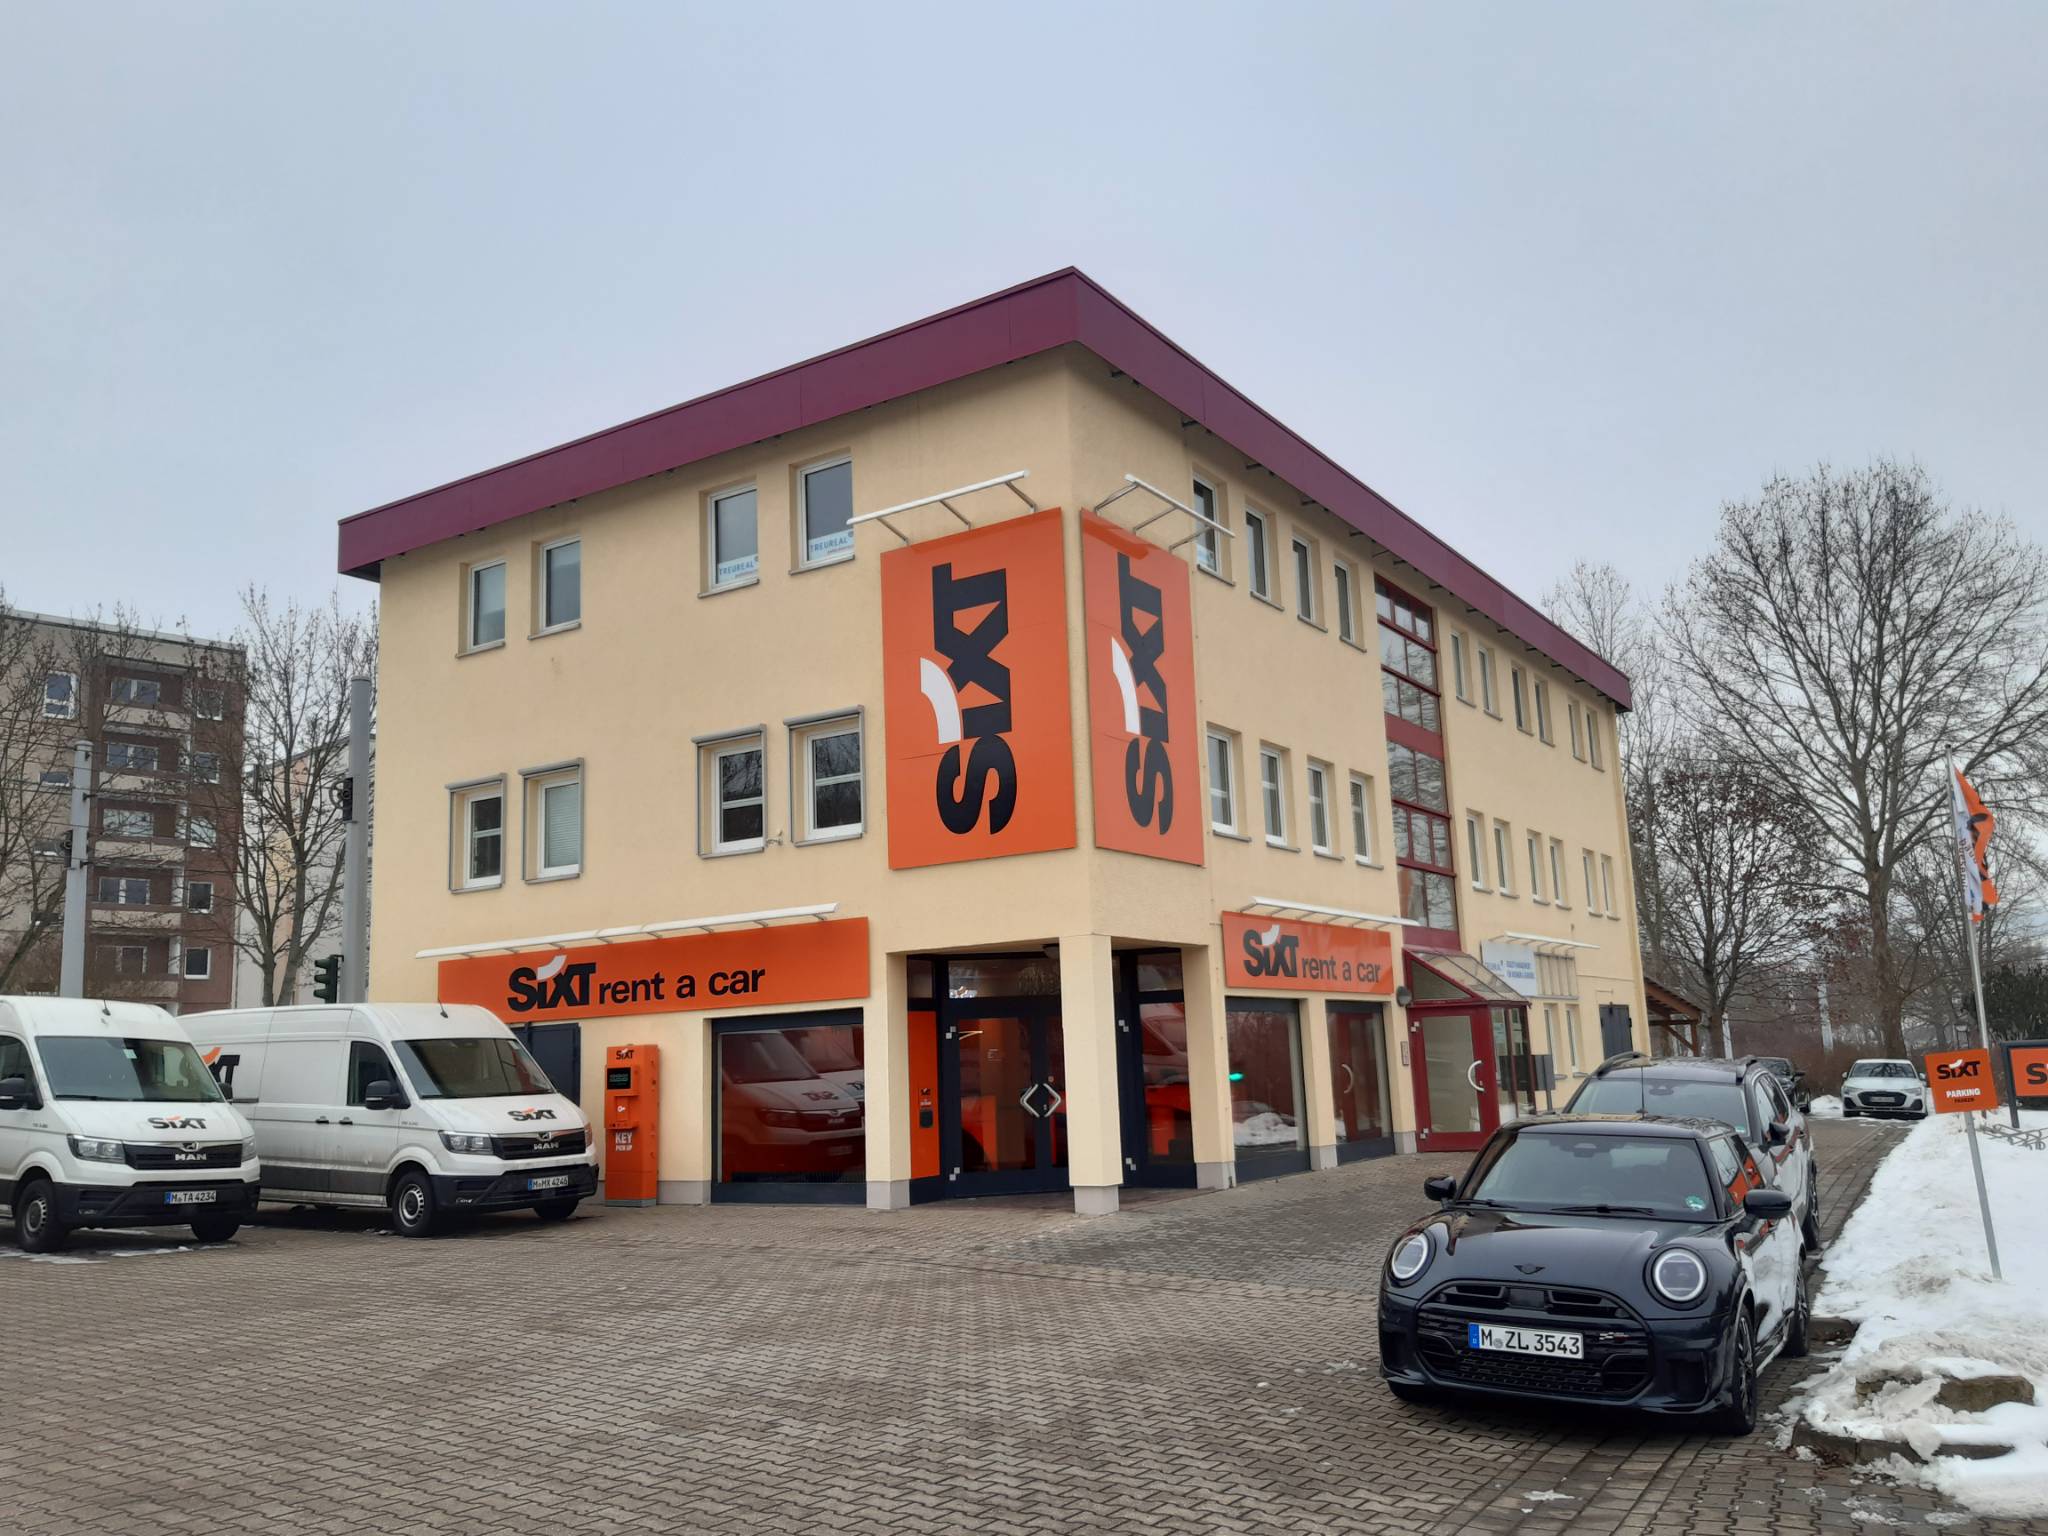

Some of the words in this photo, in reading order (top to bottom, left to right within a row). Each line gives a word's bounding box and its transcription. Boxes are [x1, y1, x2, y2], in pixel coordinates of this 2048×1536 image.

[810, 537, 848, 553] TREUREAL
[1302, 956, 1337, 980] rent
[1342, 961, 1352, 981] a
[1356, 961, 1381, 983] car
[599, 972, 665, 1004] rent
[676, 975, 696, 999] a
[708, 968, 766, 996] car
[1946, 1088, 1981, 1098] PARKING
[615, 1132, 633, 1144] KEY
[533, 1142, 559, 1150] MAN
[175, 1153, 207, 1161] MAN
[1534, 1334, 1580, 1355] 3543
